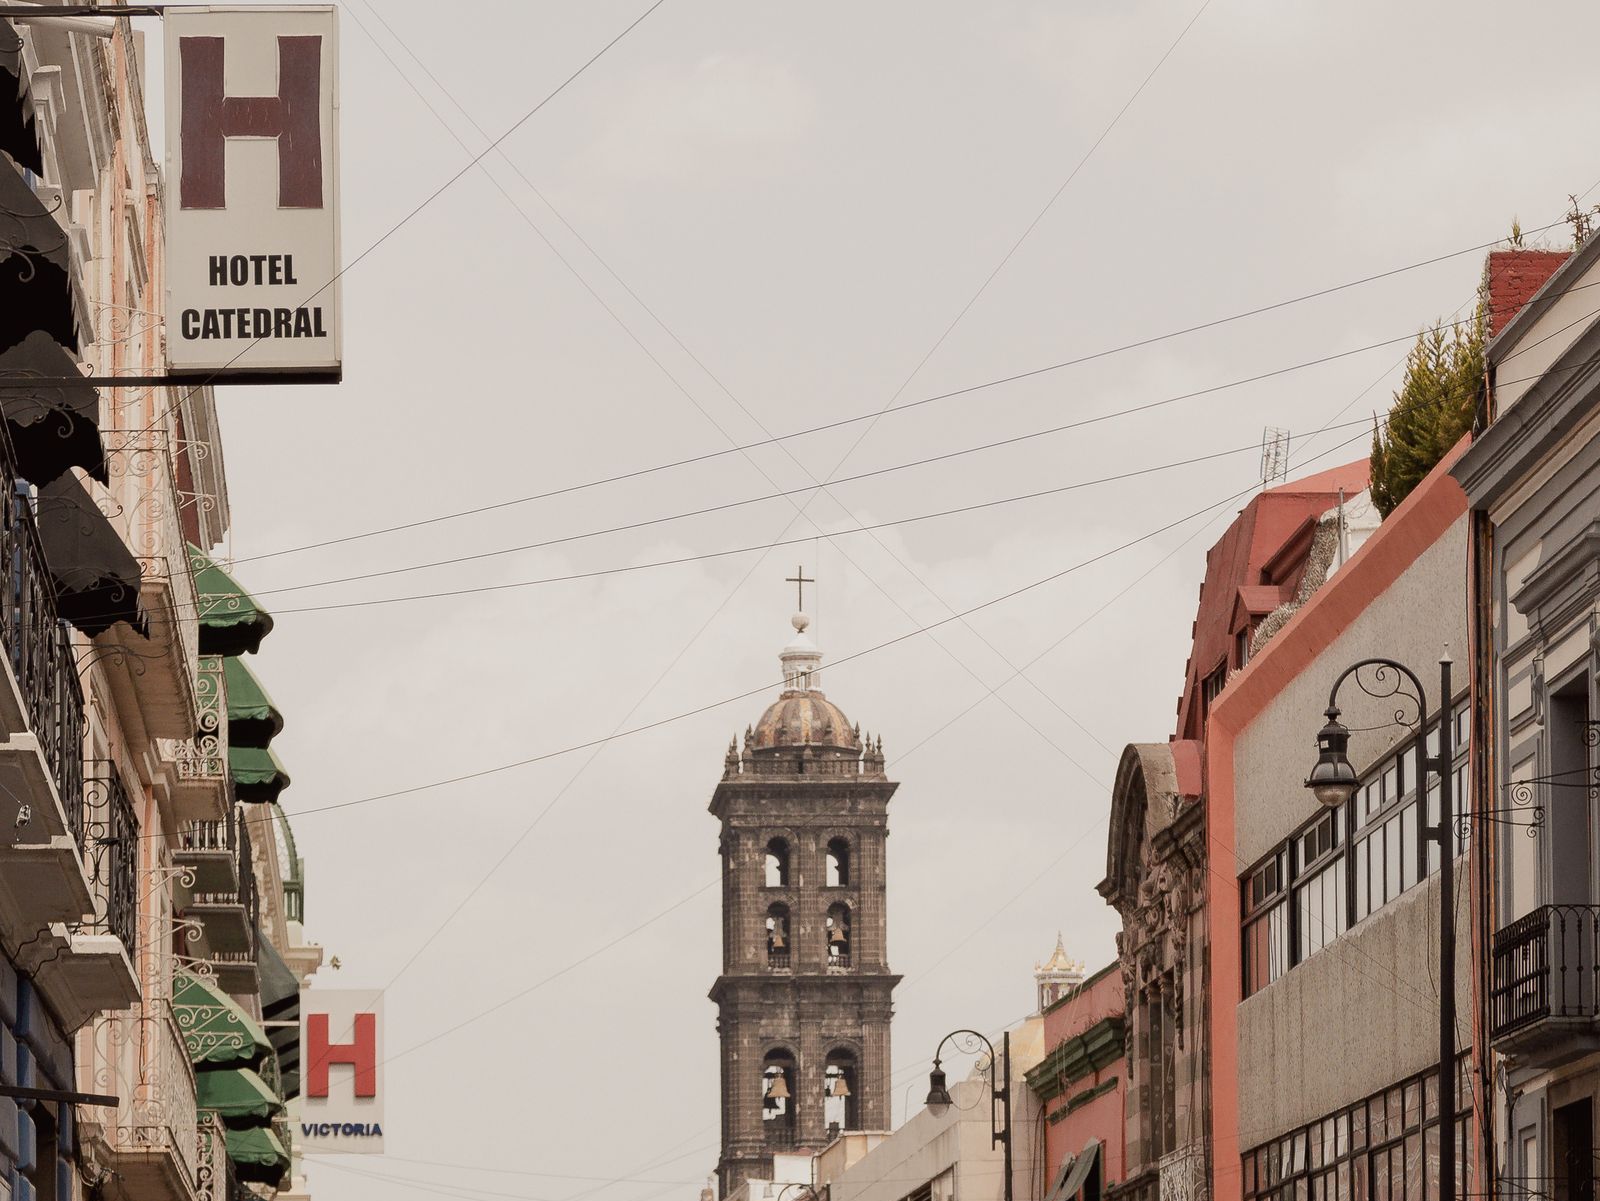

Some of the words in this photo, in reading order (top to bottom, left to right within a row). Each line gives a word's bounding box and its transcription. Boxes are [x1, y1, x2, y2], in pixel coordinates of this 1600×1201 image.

[179, 35, 324, 209] H
[209, 255, 298, 286] HOTEL
[181, 307, 327, 340] CATEDRAL
[307, 1013, 376, 1098] H
[302, 1123, 383, 1137] VICTORIA
